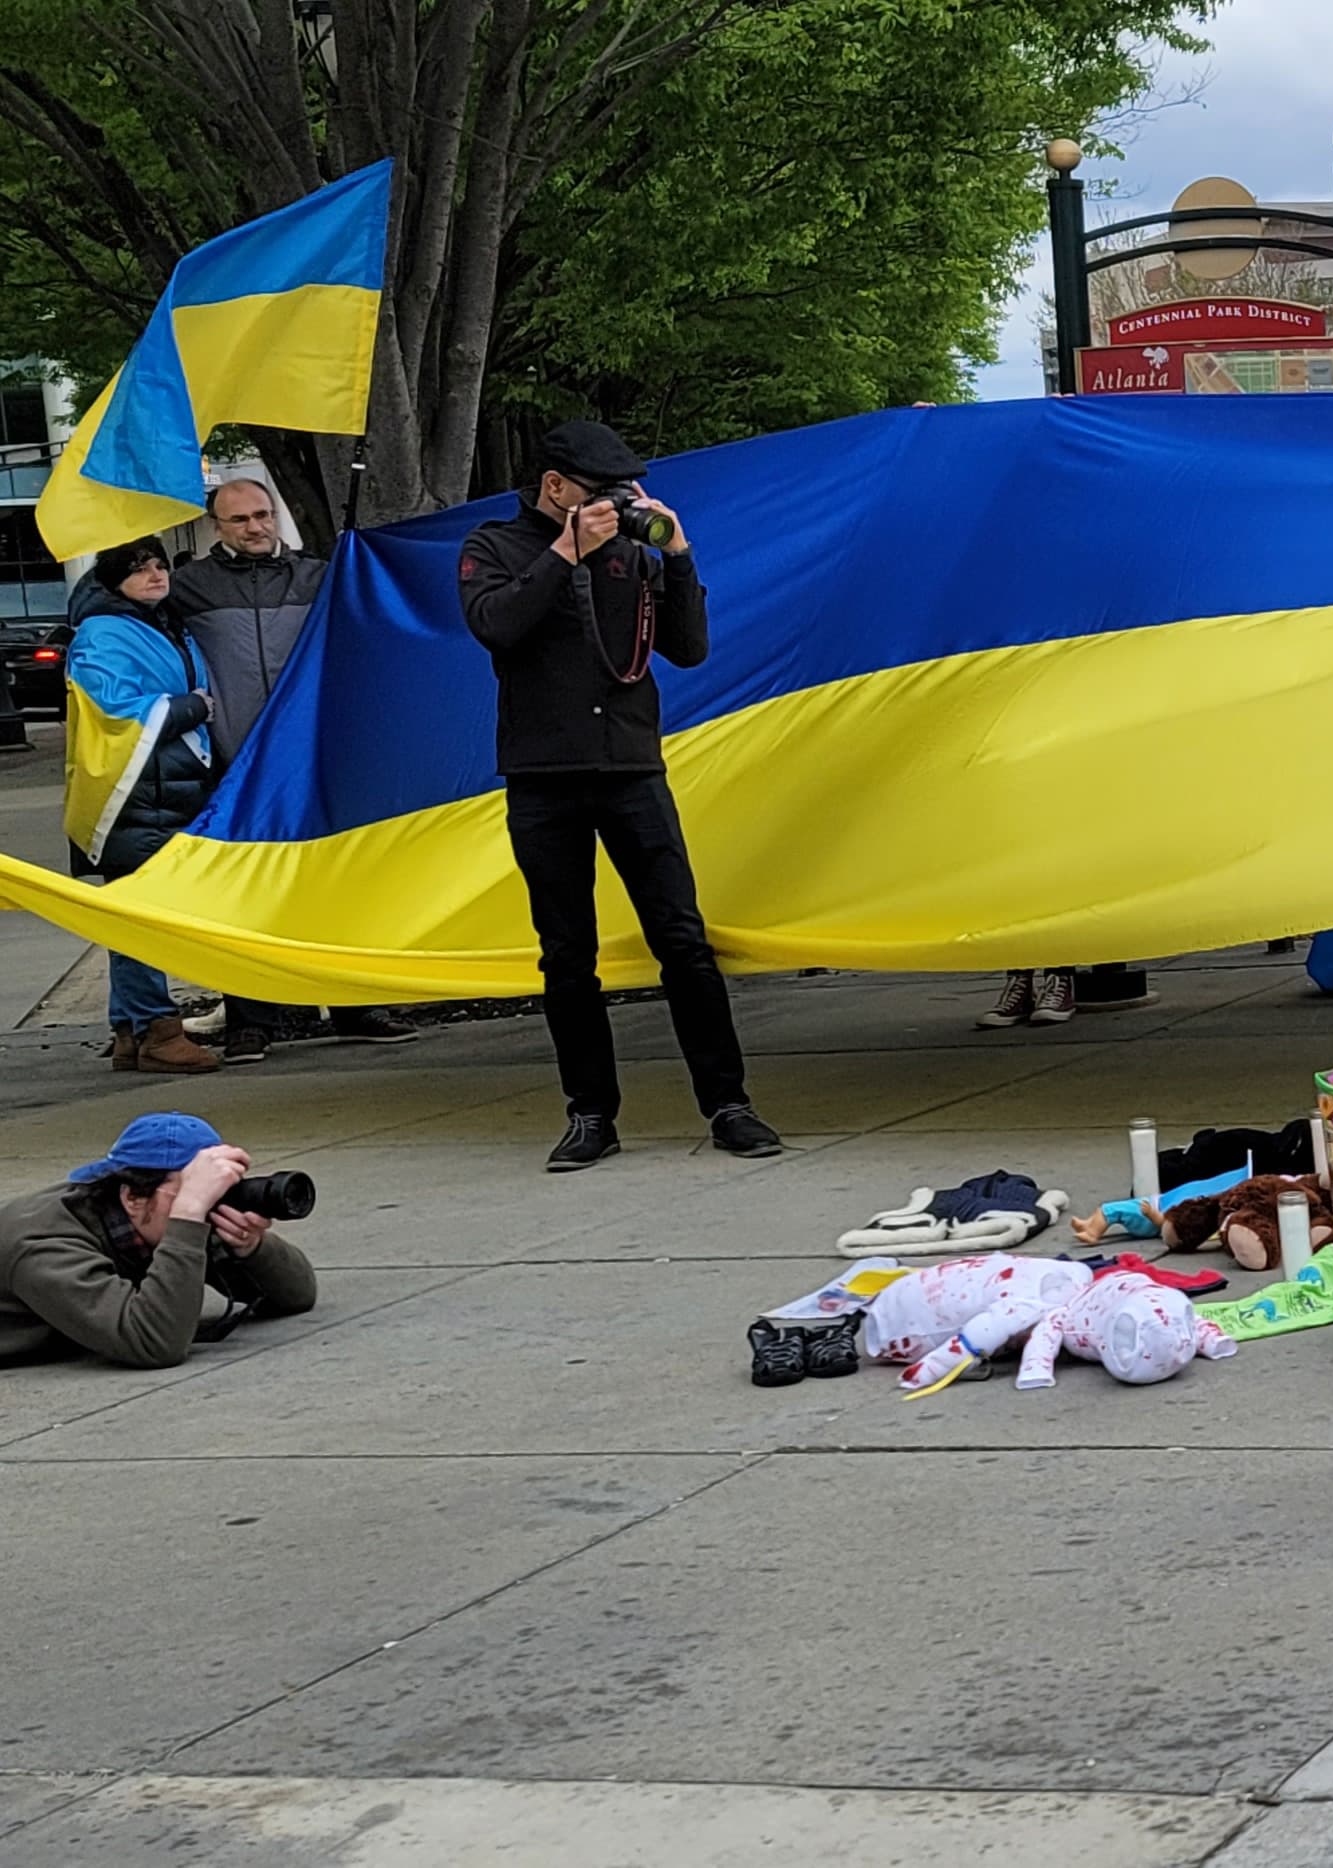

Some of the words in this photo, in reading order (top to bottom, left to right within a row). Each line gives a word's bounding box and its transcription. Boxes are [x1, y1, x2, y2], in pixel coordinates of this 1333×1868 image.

[1207, 304, 1242, 317] PARK
[1247, 304, 1311, 327] DISTRICT
[1092, 367, 1169, 391] Atlanta
